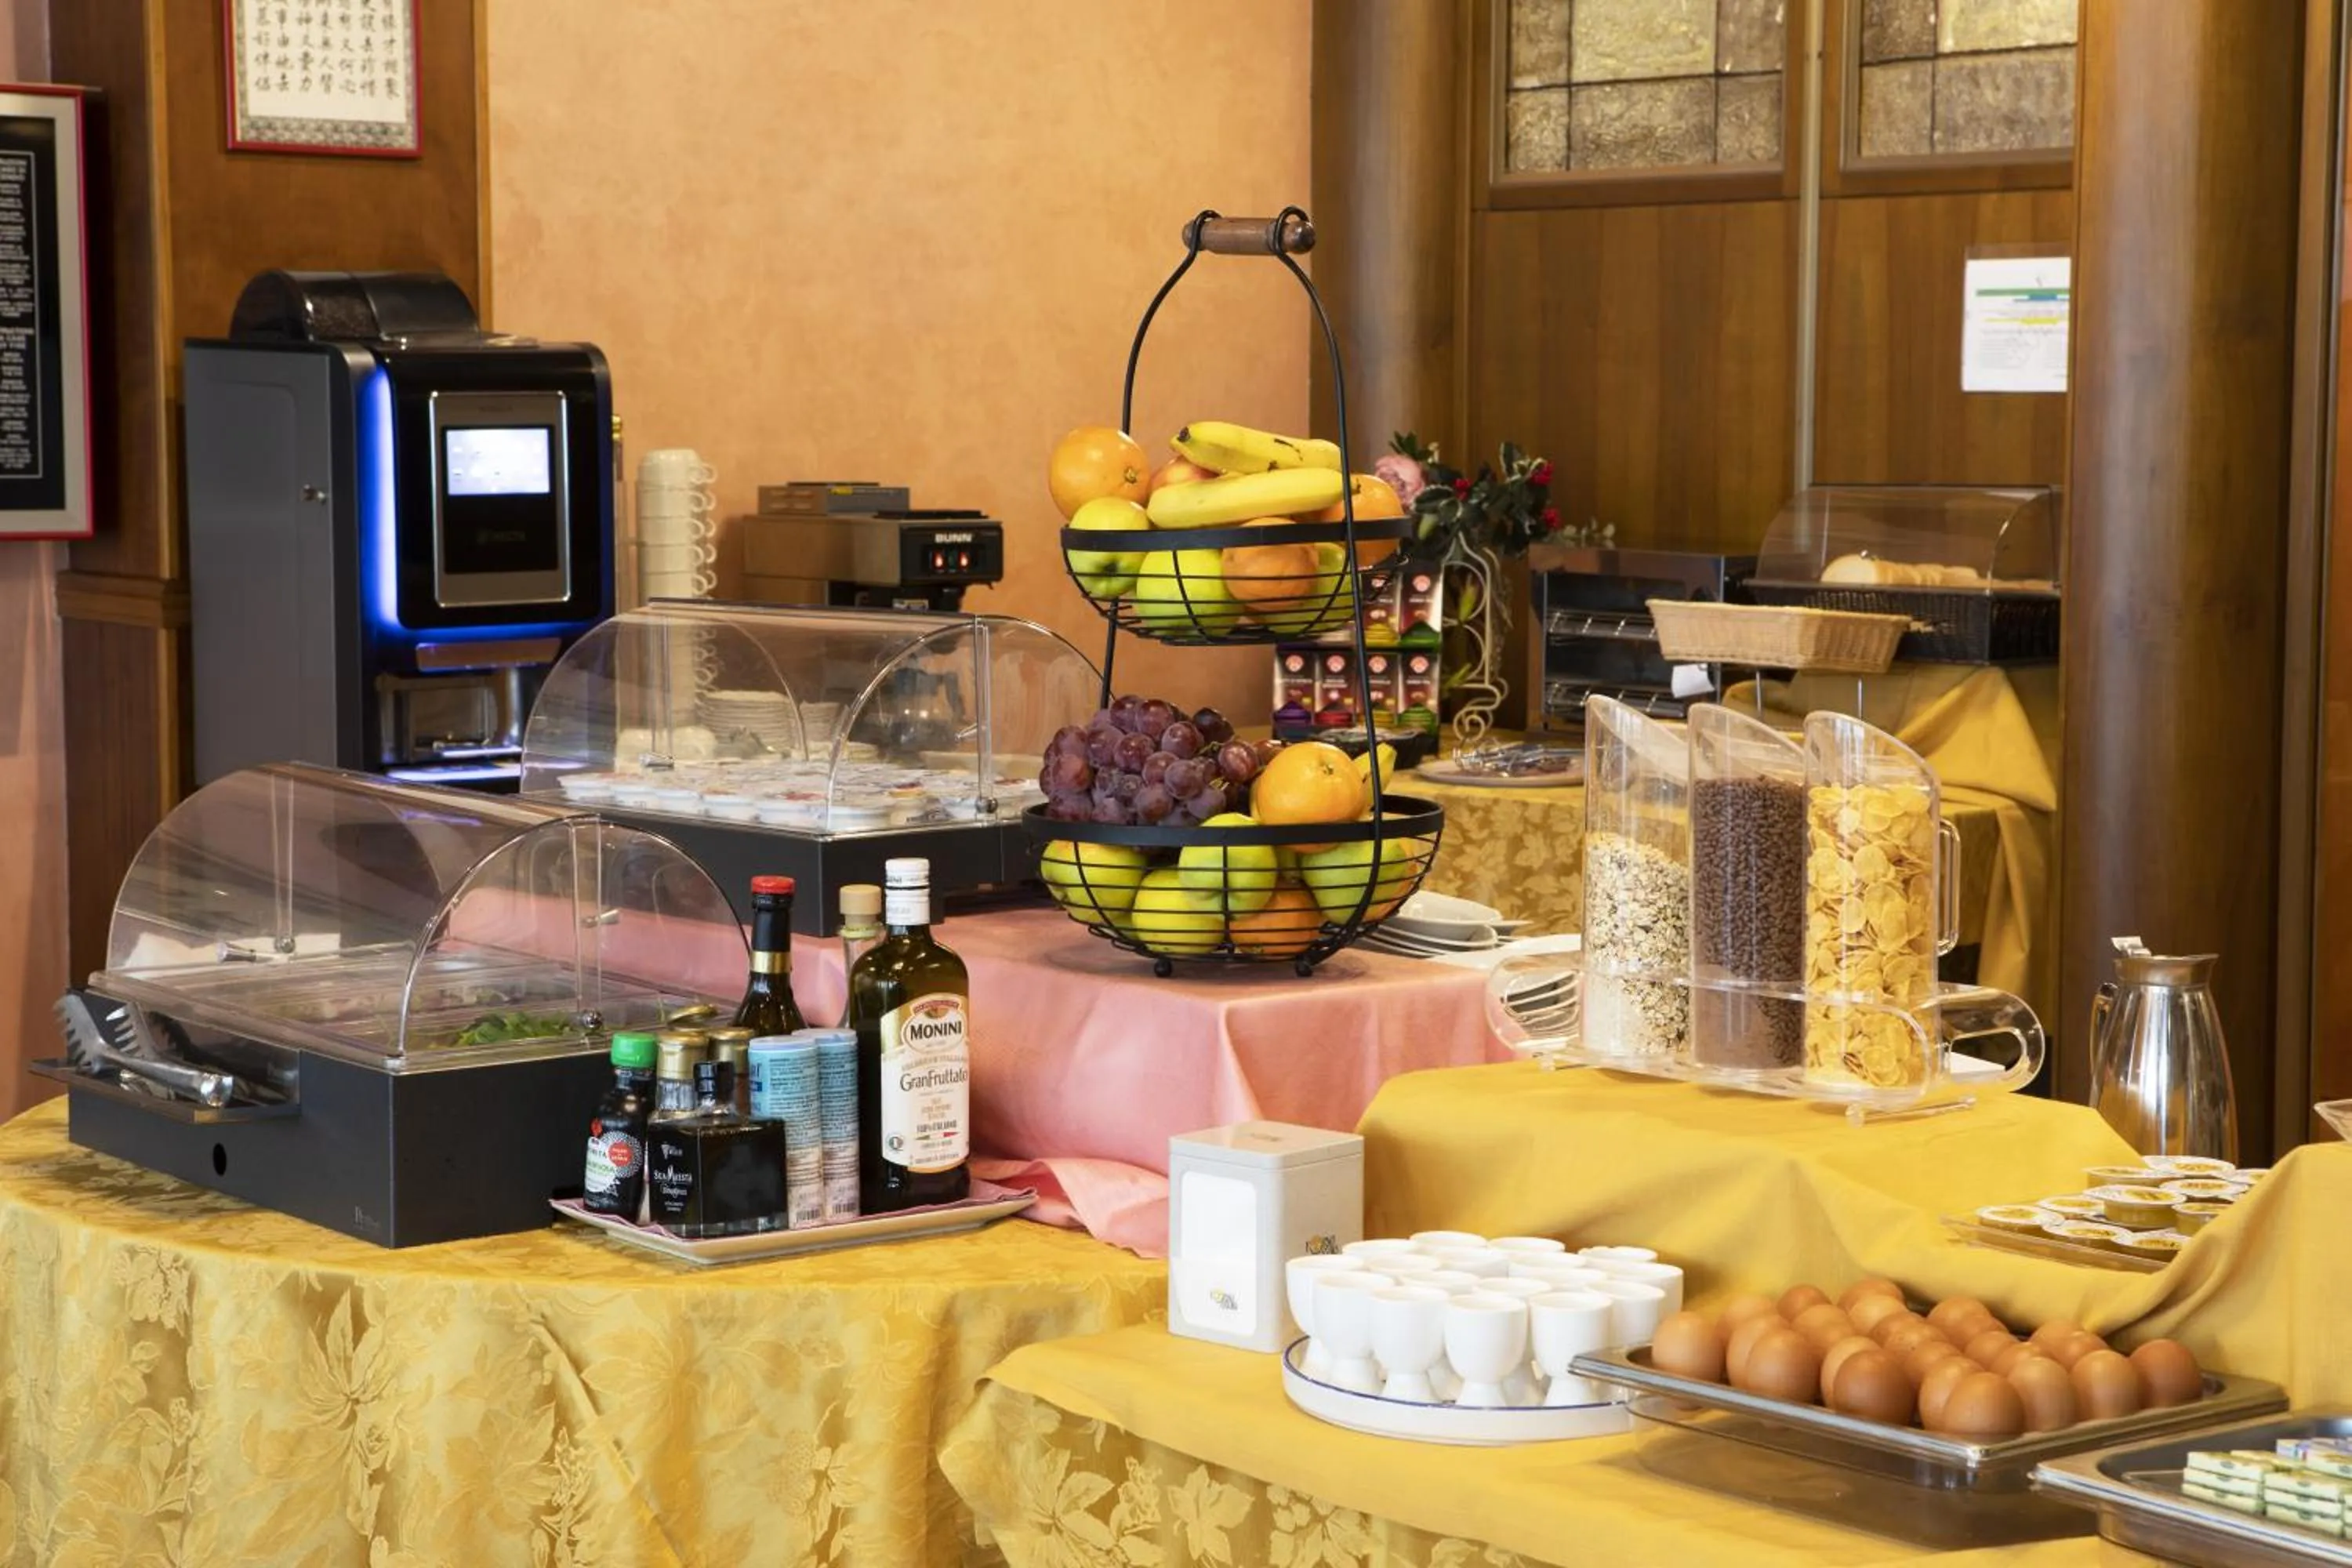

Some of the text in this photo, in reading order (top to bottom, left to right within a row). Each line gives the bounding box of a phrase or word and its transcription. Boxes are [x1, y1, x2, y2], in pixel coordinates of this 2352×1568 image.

[935, 533, 973, 543] BUNN
[909, 1021, 962, 1040] MONINI
[899, 1067, 968, 1092] GranFruttato
